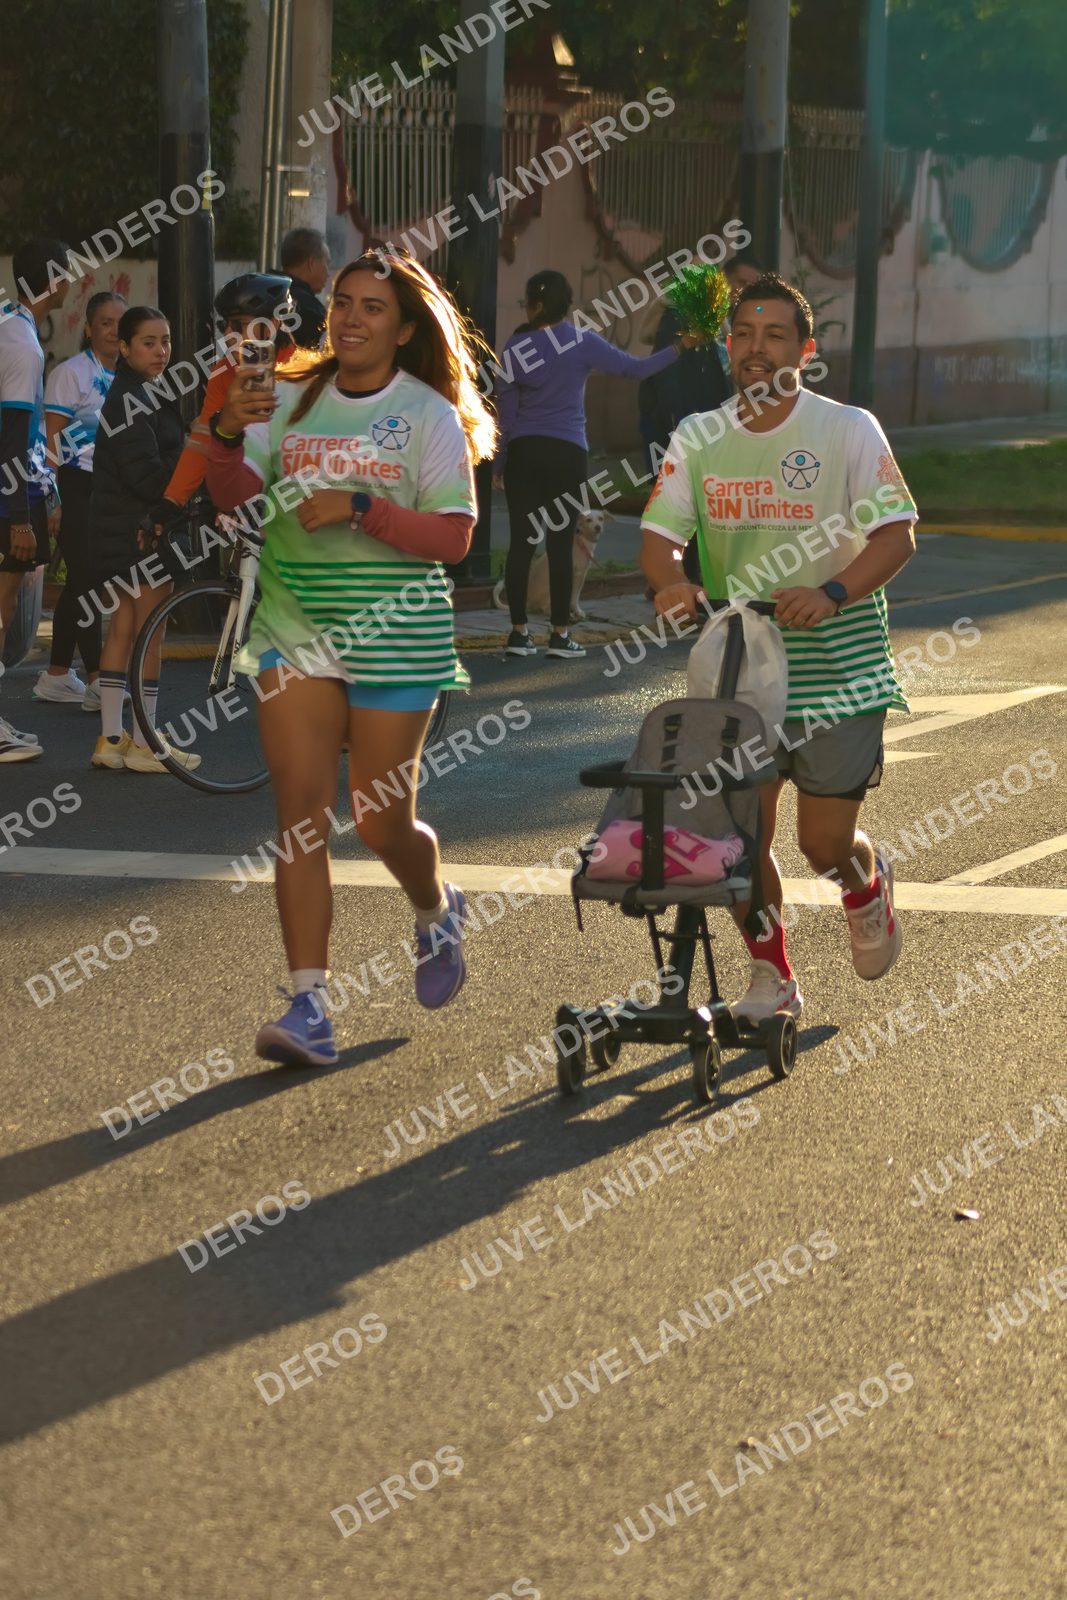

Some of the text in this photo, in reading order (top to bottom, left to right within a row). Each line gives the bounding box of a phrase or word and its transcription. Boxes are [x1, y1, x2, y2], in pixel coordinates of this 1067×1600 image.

[281, 434, 361, 452] Carrera
[282, 452, 322, 476] SIN
[703, 477, 773, 497] Carrera
[706, 498, 815, 520] SIN límites
